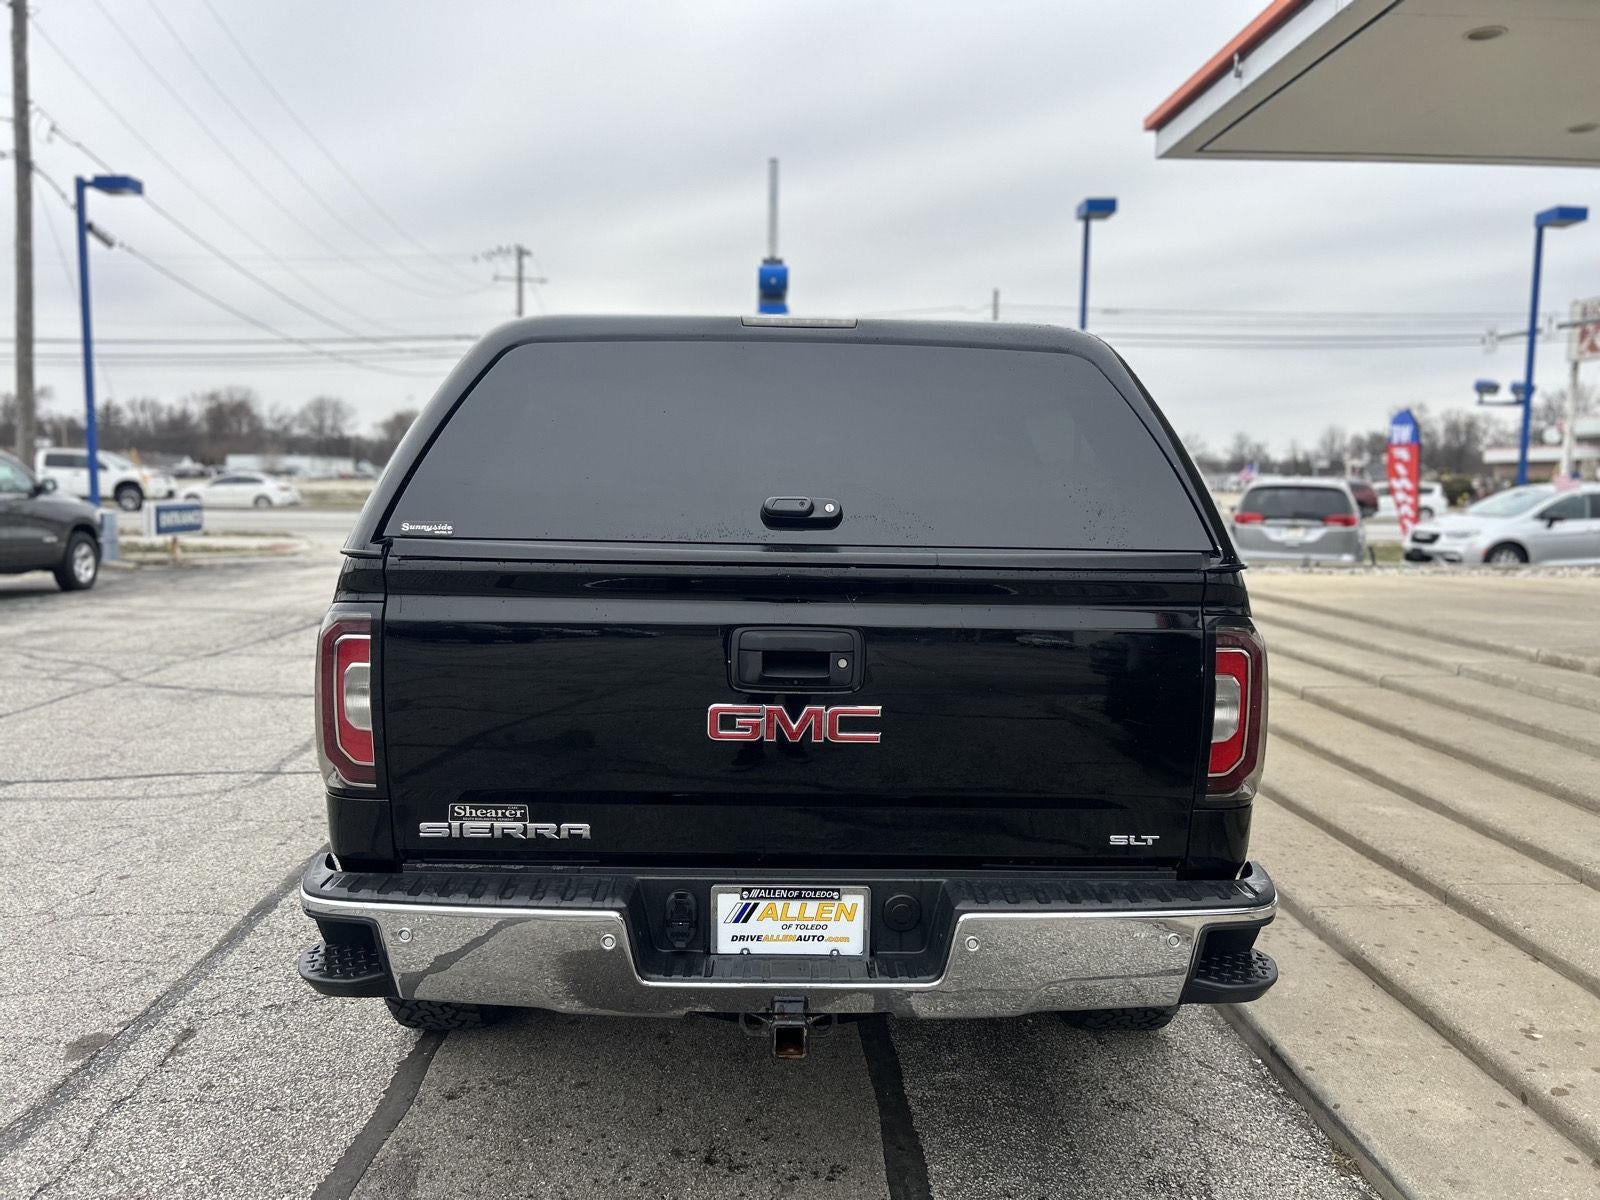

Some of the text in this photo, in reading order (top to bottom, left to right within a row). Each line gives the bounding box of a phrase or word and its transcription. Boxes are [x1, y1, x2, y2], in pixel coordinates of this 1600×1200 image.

[401, 522, 453, 532] Sunnyside
[707, 703, 882, 743] GMC
[454, 805, 525, 818] Shearer
[419, 822, 591, 839] SIERRA
[1109, 835, 1160, 845] SLT
[788, 890, 798, 898] OF
[757, 902, 858, 922] ALLEN
